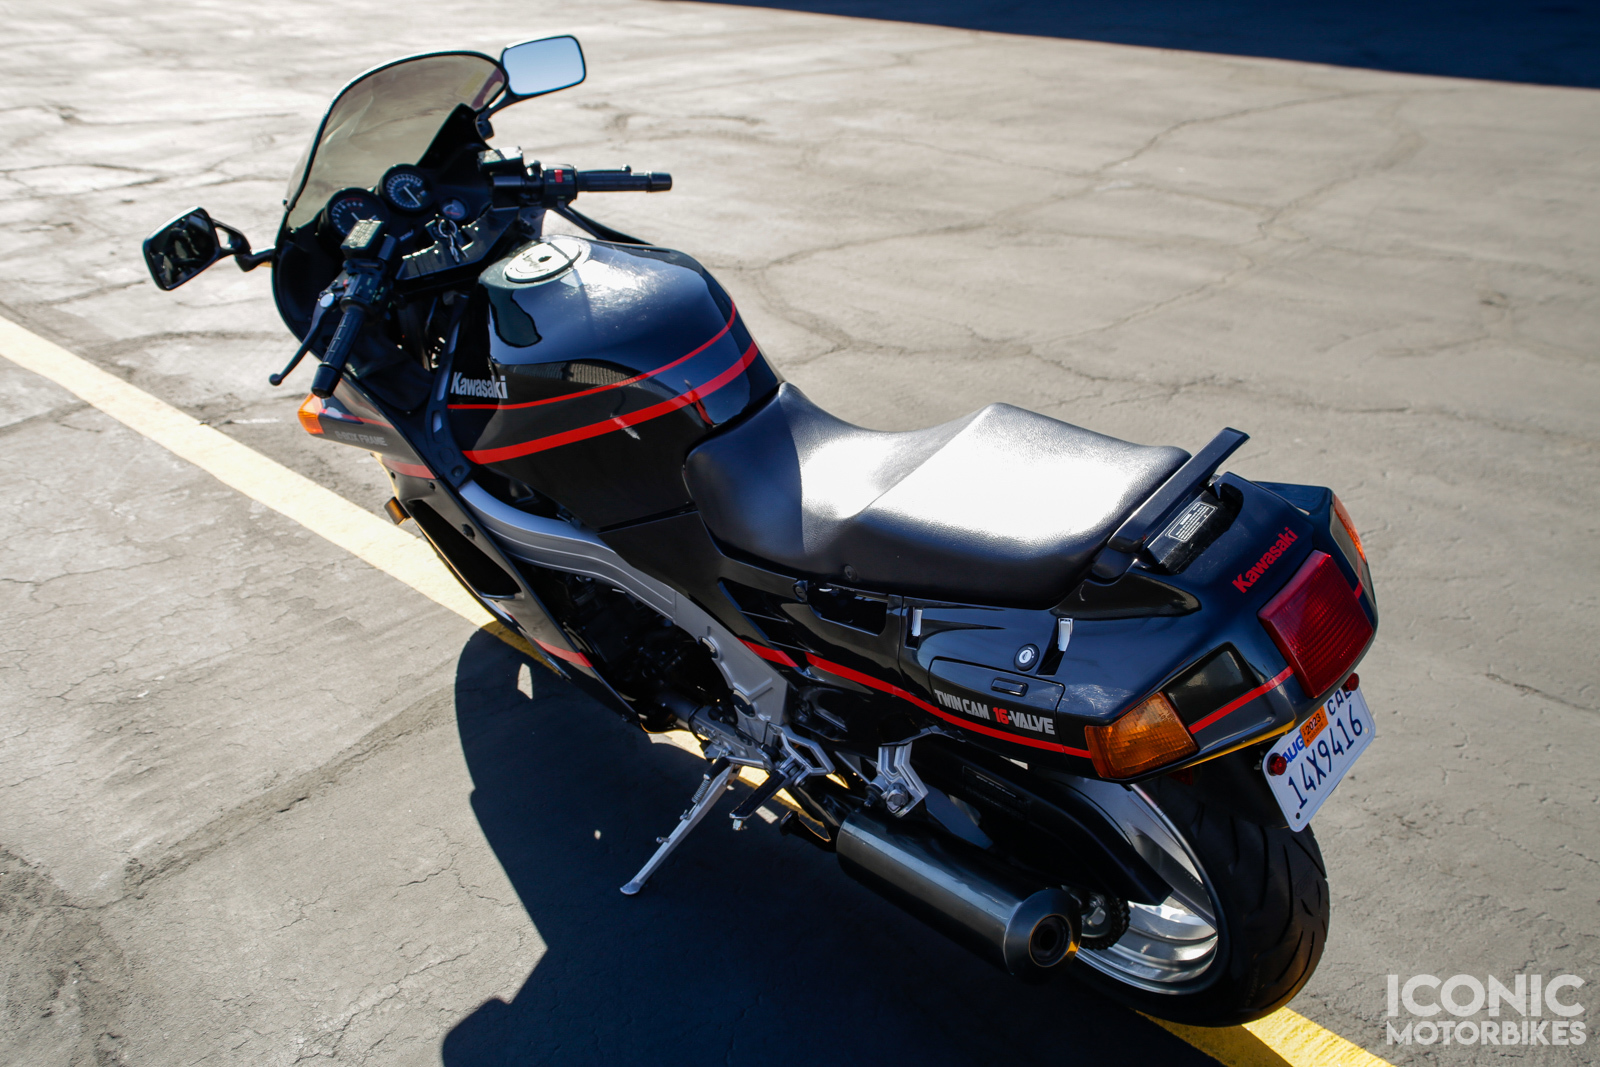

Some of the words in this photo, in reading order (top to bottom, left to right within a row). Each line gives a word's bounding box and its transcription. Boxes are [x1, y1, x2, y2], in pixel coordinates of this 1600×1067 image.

[450, 371, 508, 399] Kawasaki
[1232, 526, 1299, 594] Kawasaki
[934, 689, 964, 712] TWIN
[962, 698, 991, 720] CAM
[993, 707, 1056, 735] 16-VALVE
[1305, 712, 1322, 737] 2023
[1281, 734, 1306, 765] AUG
[1288, 704, 1363, 810] 14X9416
